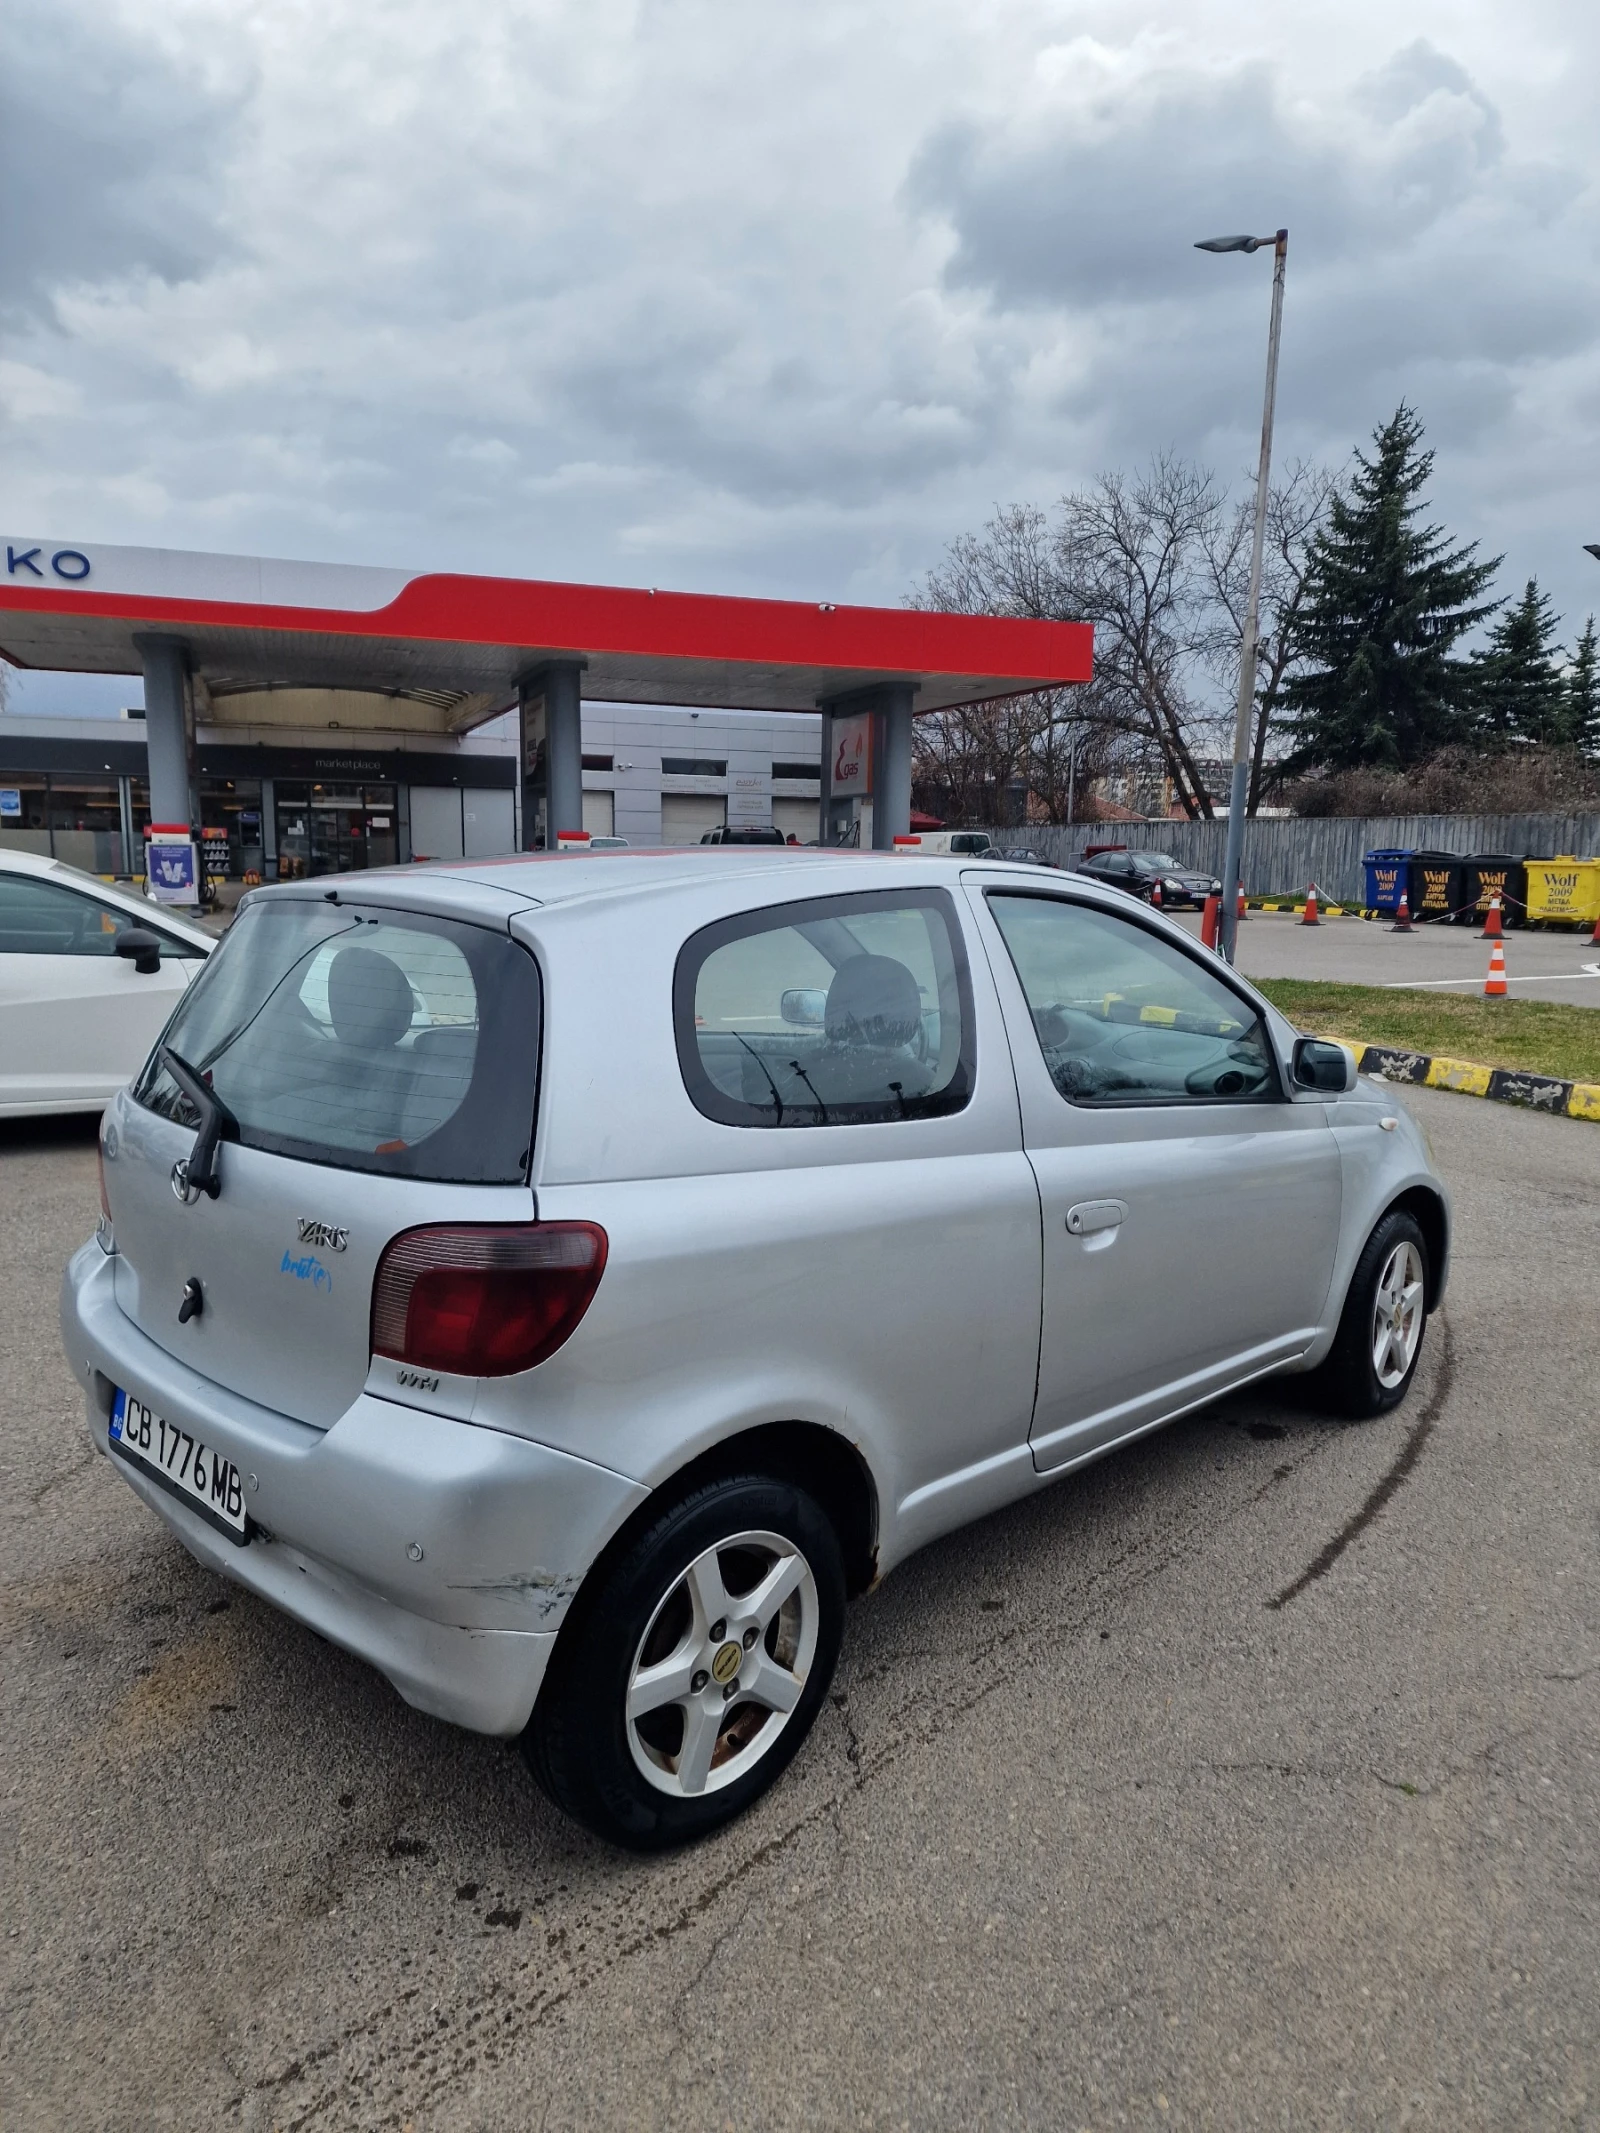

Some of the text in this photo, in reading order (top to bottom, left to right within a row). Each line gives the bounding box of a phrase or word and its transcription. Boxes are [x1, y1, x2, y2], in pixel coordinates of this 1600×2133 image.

[1374, 869, 1399, 882] Wolf
[1423, 870, 1451, 884] Wolf
[1478, 871, 1508, 885] Wolf
[1543, 872, 1581, 887] Wolf
[1378, 881, 1395, 891] 2009
[1427, 883, 1446, 893] 2009
[1548, 887, 1574, 897] 2009
[112, 1413, 123, 1431] BG
[126, 1396, 243, 1519] CB 1776 MB
